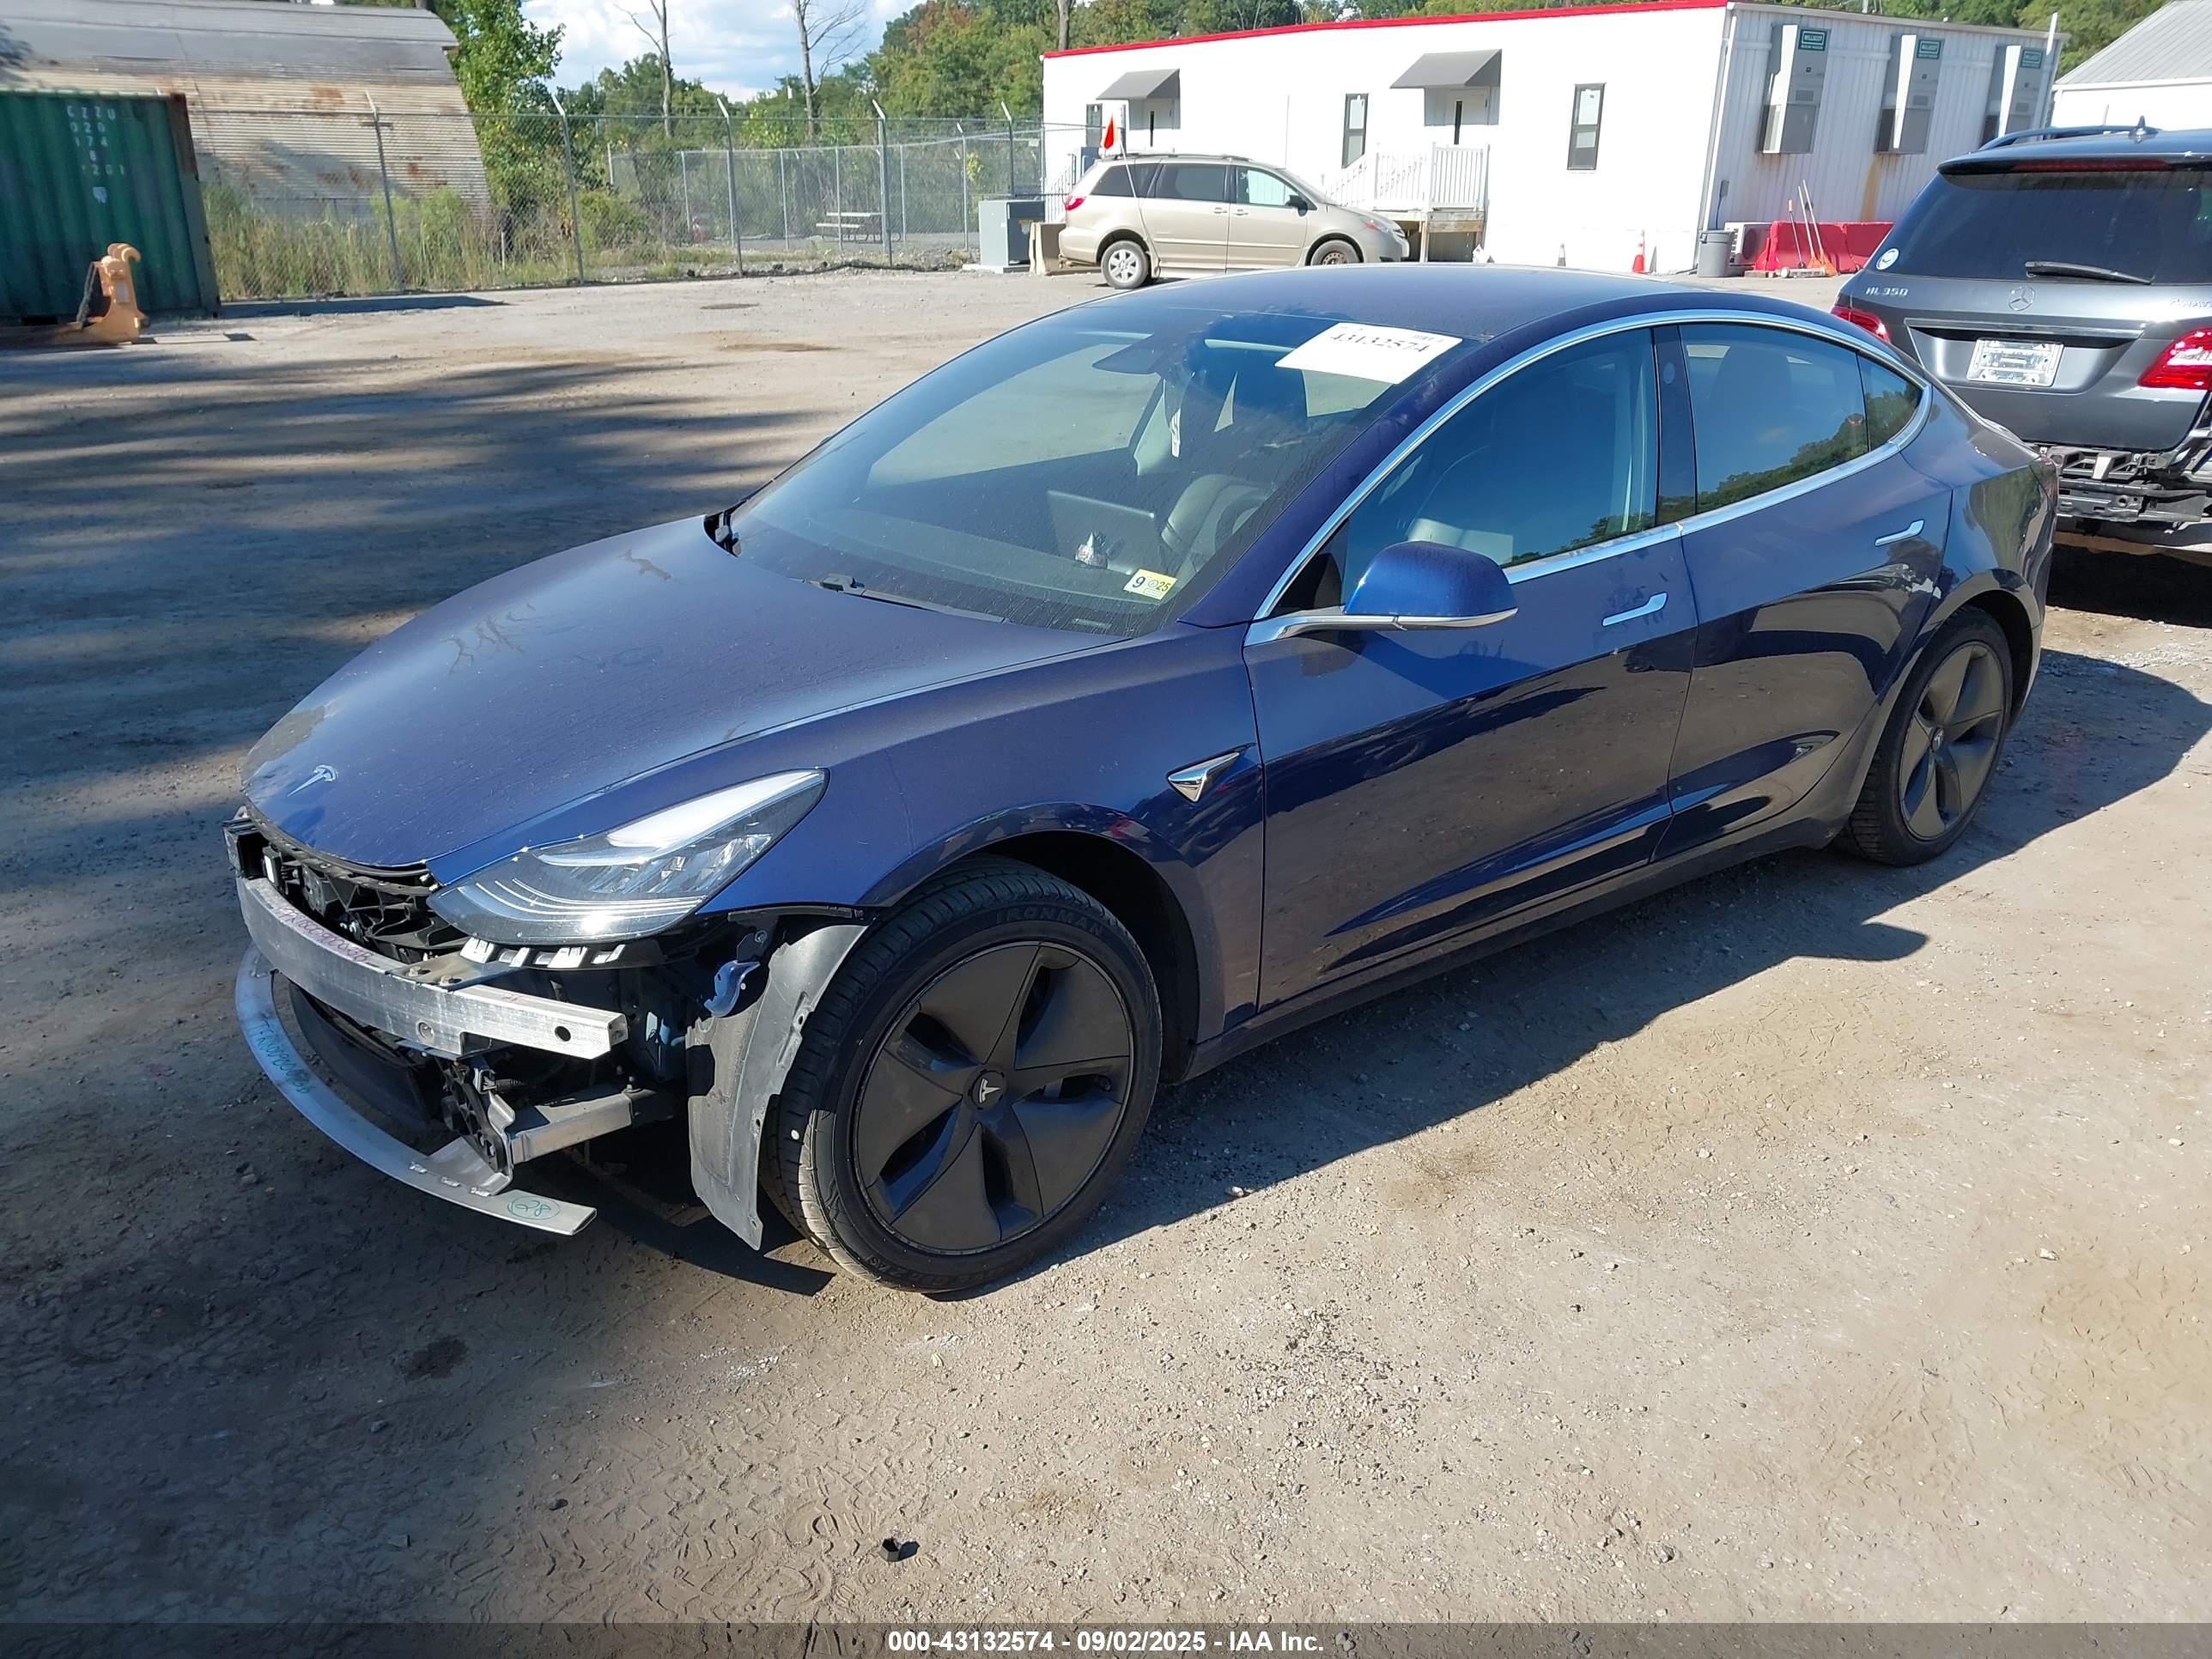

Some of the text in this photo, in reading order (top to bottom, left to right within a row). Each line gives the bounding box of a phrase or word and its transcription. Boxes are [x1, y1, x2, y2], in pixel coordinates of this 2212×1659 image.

[1132, 576, 1171, 592] 9 25
[996, 906, 1100, 937] IRONMAN
[514, 1200, 551, 1217] 28
